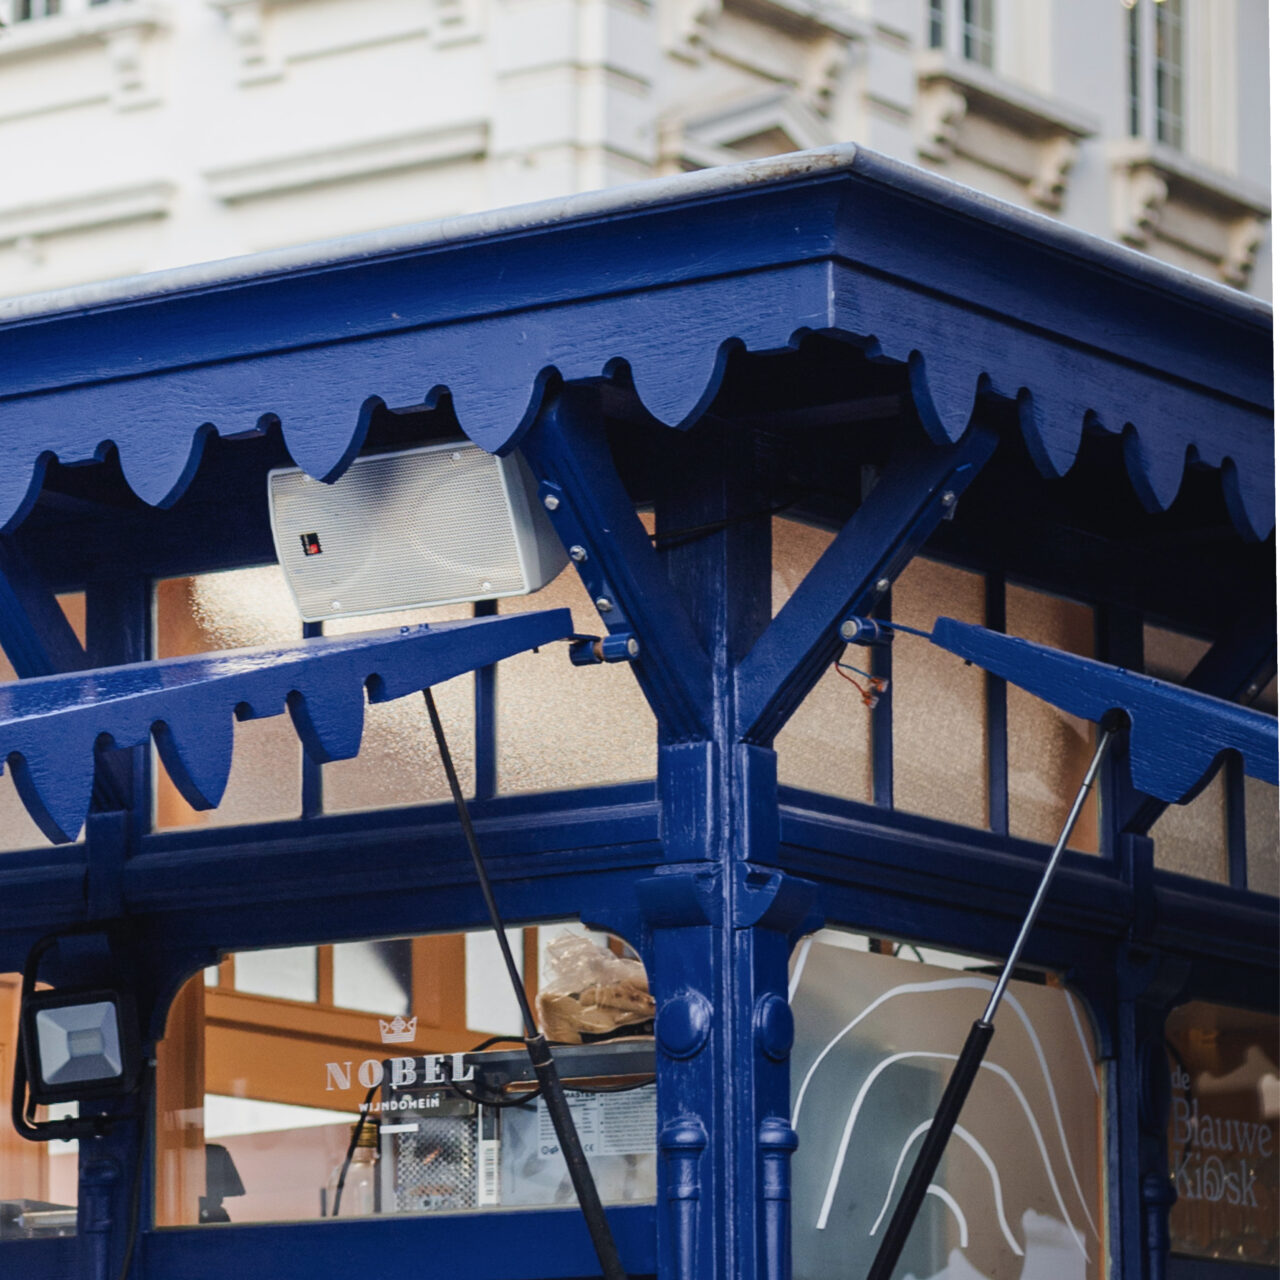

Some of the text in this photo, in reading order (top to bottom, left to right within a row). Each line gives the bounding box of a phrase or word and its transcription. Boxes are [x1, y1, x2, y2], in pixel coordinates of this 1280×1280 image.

[325, 1053, 474, 1091] NOBEL
[1171, 1064, 1190, 1090] de
[358, 1098, 440, 1112] WIJNDOMEIN
[1172, 1096, 1273, 1157] Blauwe
